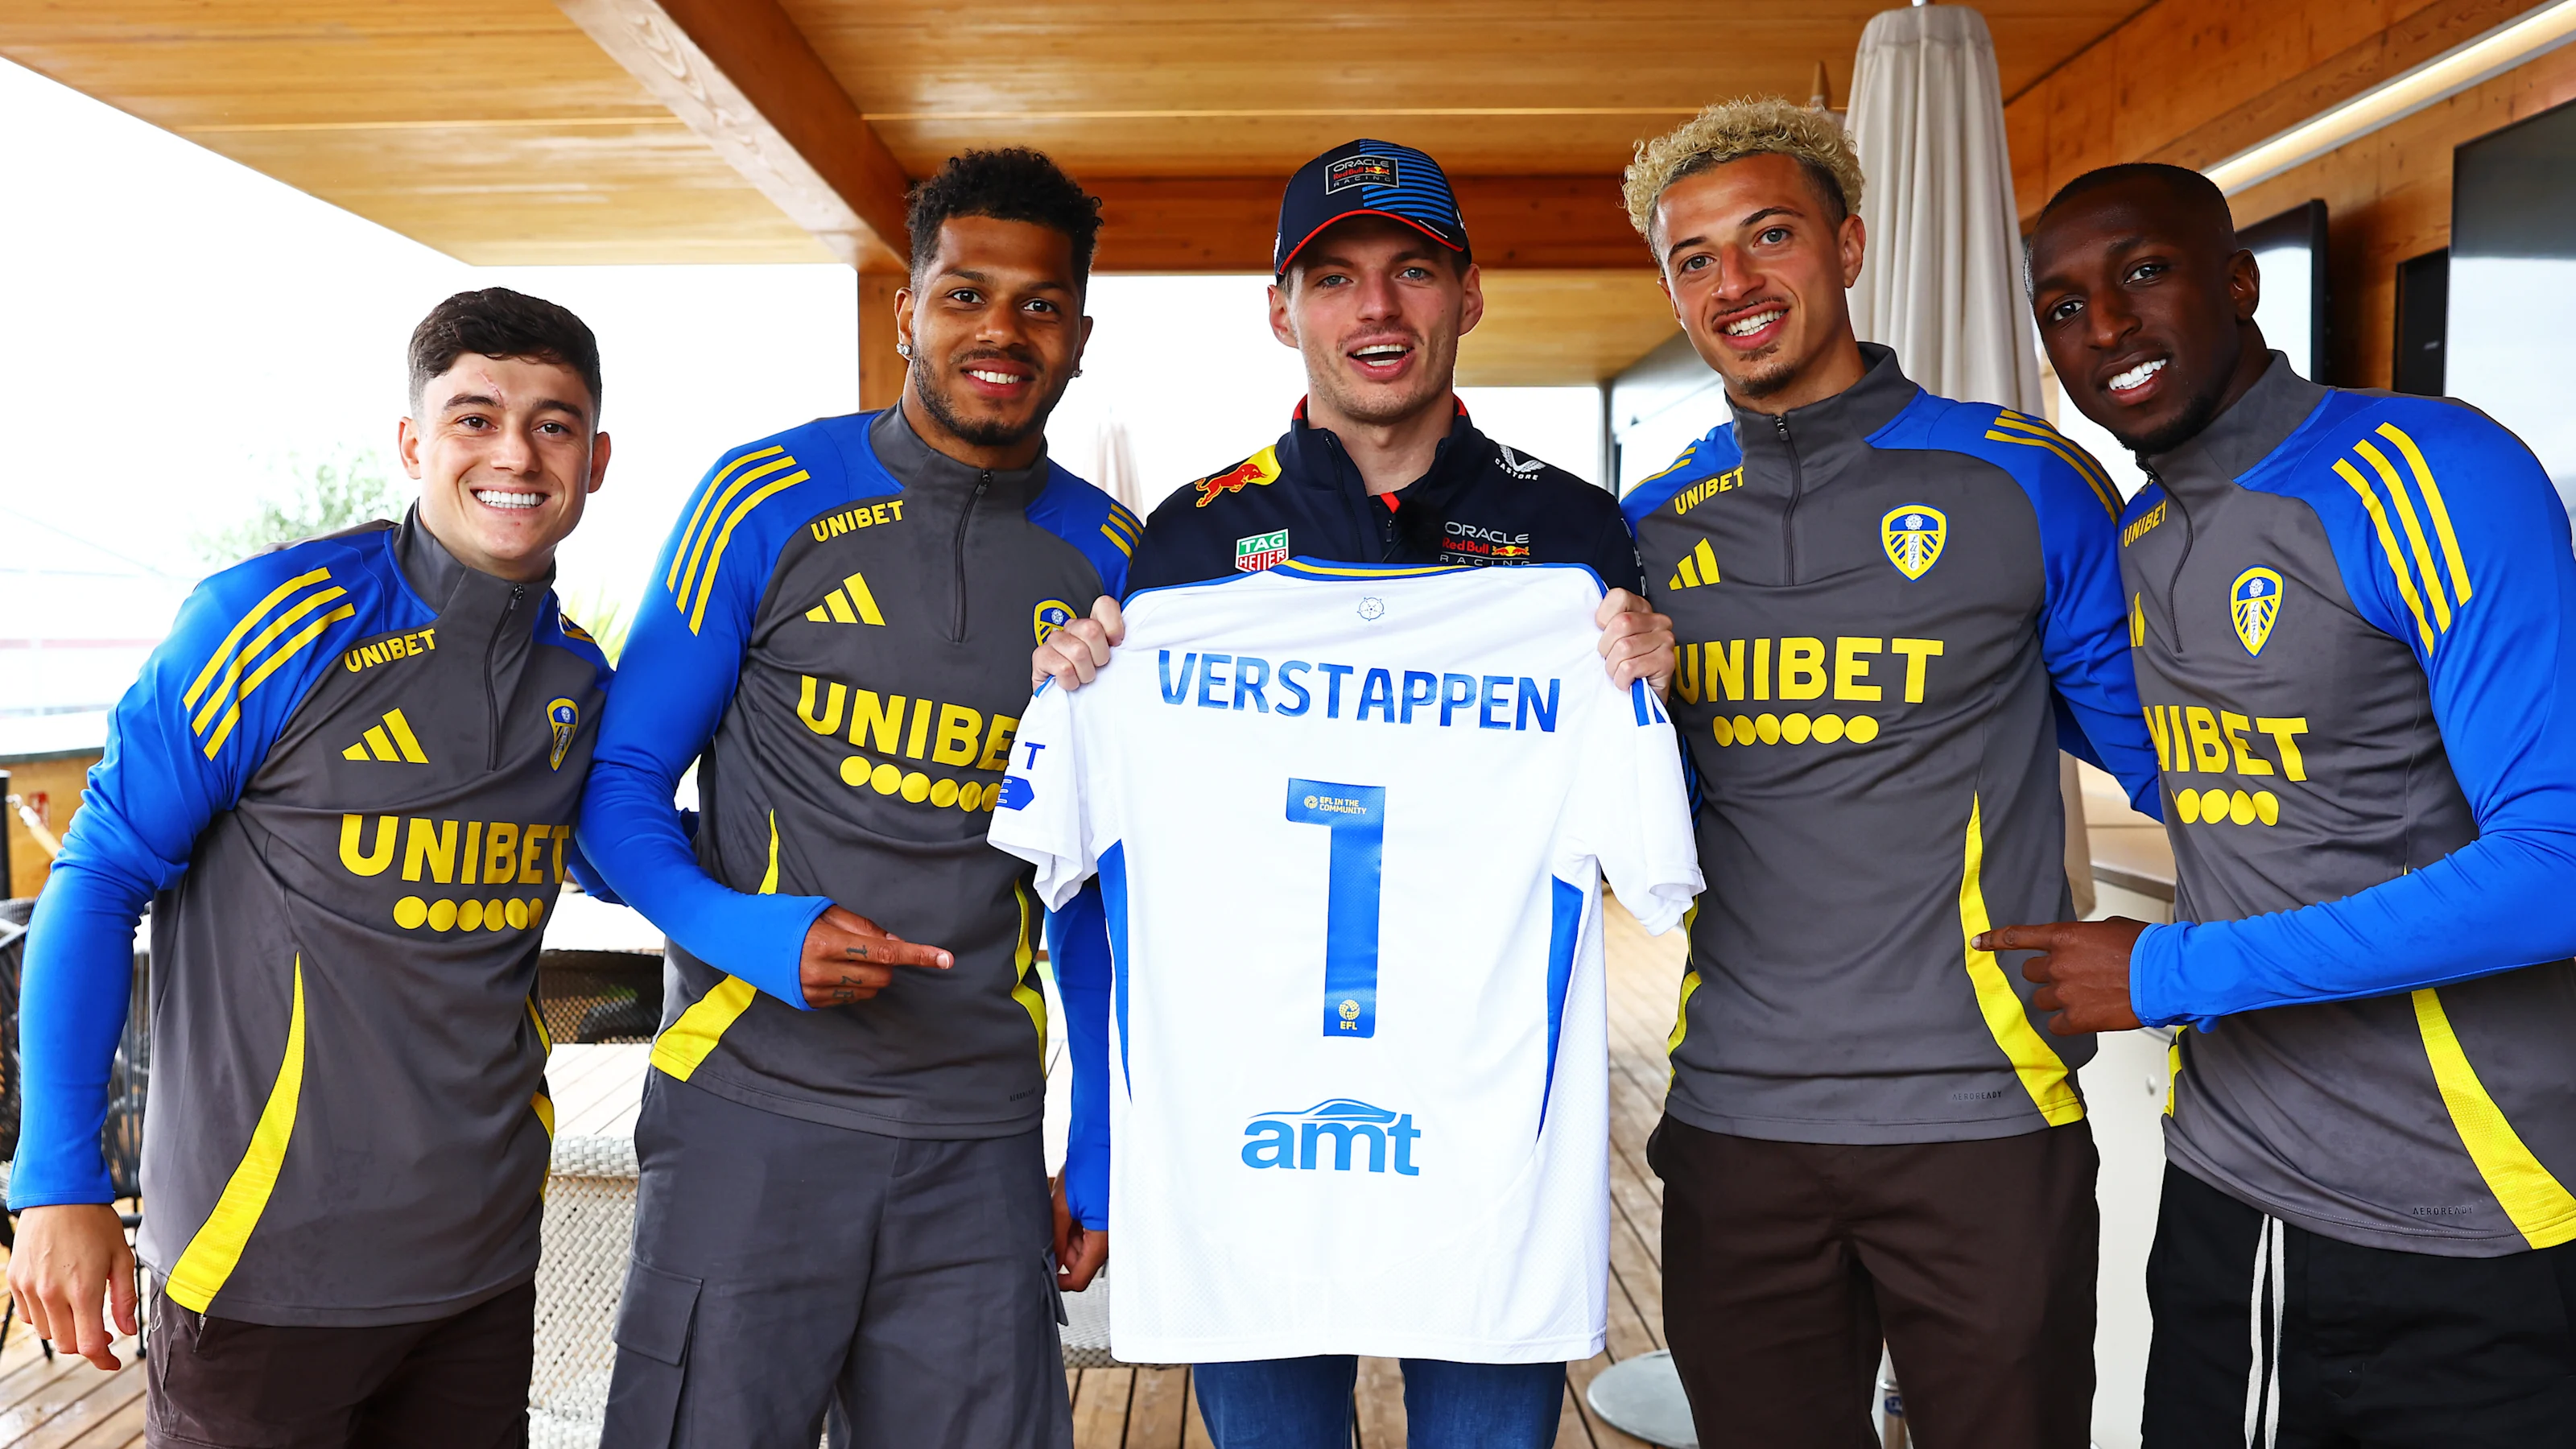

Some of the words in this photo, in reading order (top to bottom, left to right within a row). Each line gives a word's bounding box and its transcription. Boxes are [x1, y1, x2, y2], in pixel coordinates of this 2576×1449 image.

[1333, 159, 1389, 172] ORACLE
[1333, 175, 1391, 188] RACING
[1495, 458, 1539, 481] CASTORE
[1674, 466, 1745, 516] UNIBET
[811, 500, 904, 543] UNIBET
[1444, 521, 1530, 545] ORACLE
[2124, 499, 2167, 547] UNIBET
[1241, 534, 1284, 553] TAG
[1442, 537, 1466, 551] Red
[1467, 540, 1489, 555] Bull
[344, 628, 436, 673] UNIBET
[1673, 636, 1944, 704] UNIBET
[1158, 650, 1561, 733] VERSTAPPEN
[796, 674, 1020, 772] UNIBE
[2142, 704, 2310, 782] NIBET
[1319, 796, 1333, 805] EFL
[1334, 798, 1344, 806] IN
[1344, 799, 1360, 807] THE
[1319, 803, 1367, 815] COMMUNITY
[338, 813, 570, 885] UNIBET
[1286, 778, 1385, 1038] 1
[1340, 1020, 1358, 1030] EFL
[1952, 1090, 2002, 1100] AEROREADY
[1241, 1113, 1422, 1176] amt
[2413, 1205, 2473, 1216] AEROREADY
